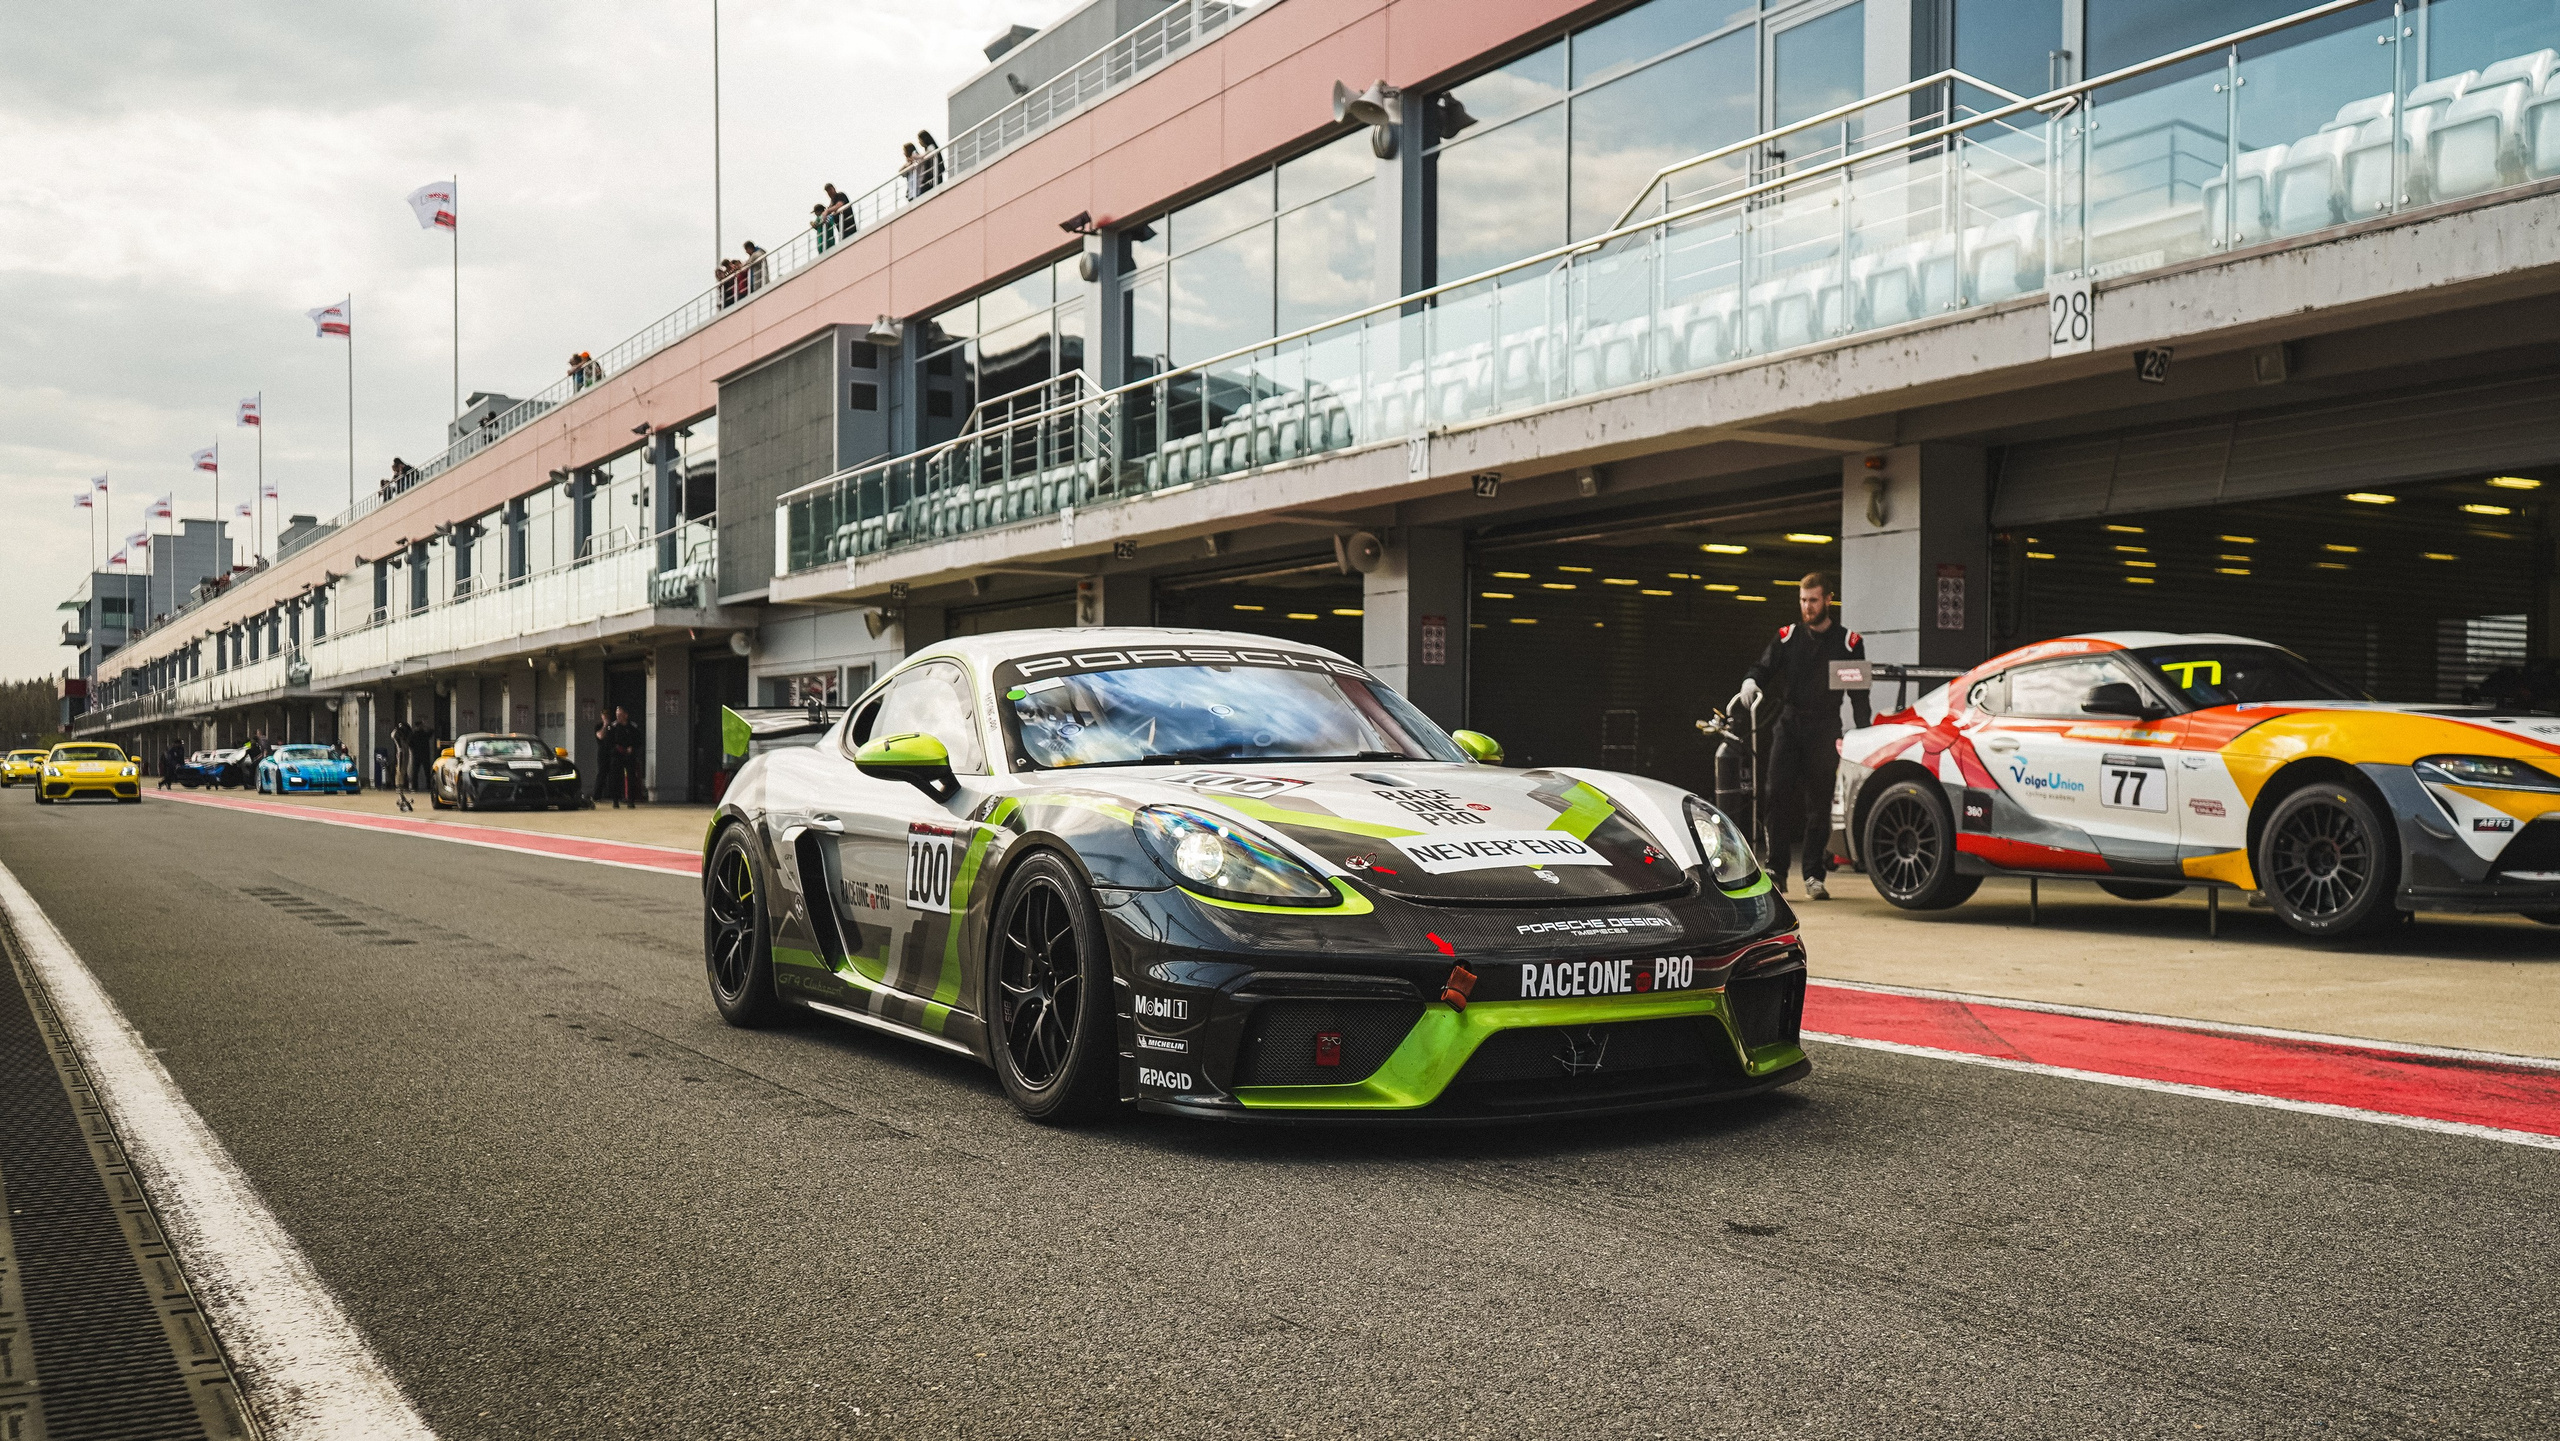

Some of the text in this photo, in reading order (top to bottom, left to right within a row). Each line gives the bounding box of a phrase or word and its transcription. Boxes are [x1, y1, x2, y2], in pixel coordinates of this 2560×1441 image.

[2052, 290, 2089, 345] 28
[2145, 350, 2169, 379] 28
[1409, 437, 1427, 474] 27
[1478, 475, 1498, 496] 27
[1015, 648, 1372, 683] PORSCHE
[2161, 660, 2222, 690] 77
[1162, 773, 1285, 794] 100
[1372, 788, 1461, 801] RACE
[2111, 769, 2148, 806] 77
[1395, 799, 1465, 813] ONE
[1416, 811, 1486, 827] PRO
[908, 840, 949, 906] 100
[874, 882, 891, 911] PRO
[1516, 916, 1673, 935] PORSCHE DESIGN
[1570, 927, 1629, 937] TIMEPIECES
[1653, 954, 1694, 991] PRO
[1135, 994, 1171, 1018] Mobil
[1148, 1039, 1185, 1051] MICHELIN
[1150, 1068, 1193, 1091] PAGID
